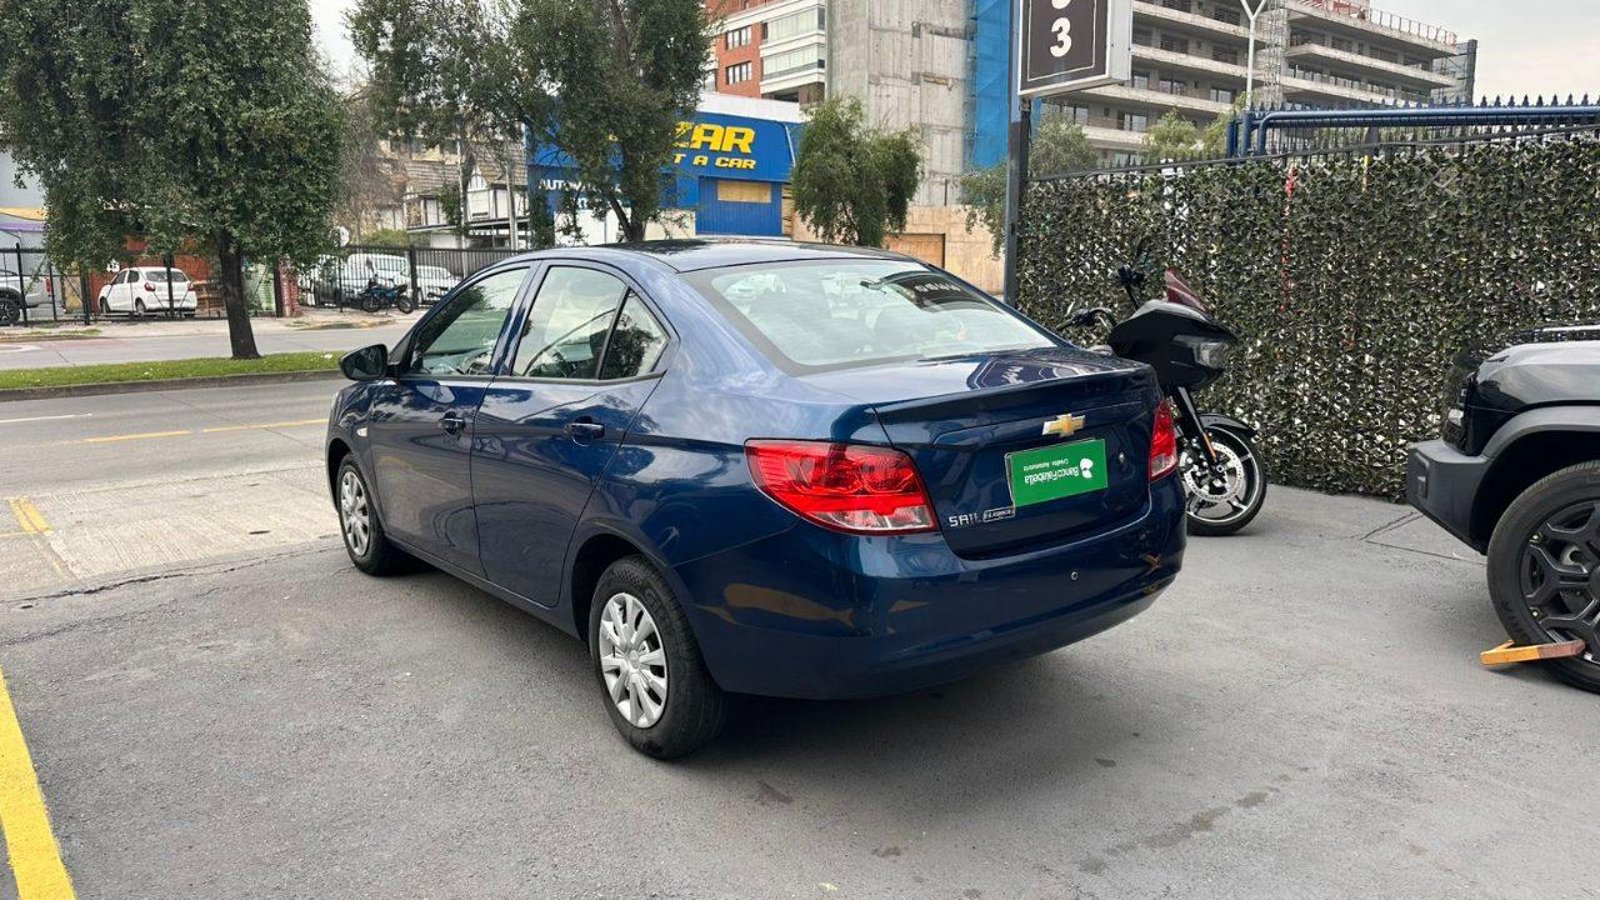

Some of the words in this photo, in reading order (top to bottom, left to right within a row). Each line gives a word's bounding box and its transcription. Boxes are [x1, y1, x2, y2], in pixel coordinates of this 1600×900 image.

[1050, 17, 1072, 57] 3
[693, 155, 709, 166] A
[715, 156, 756, 169] CAR
